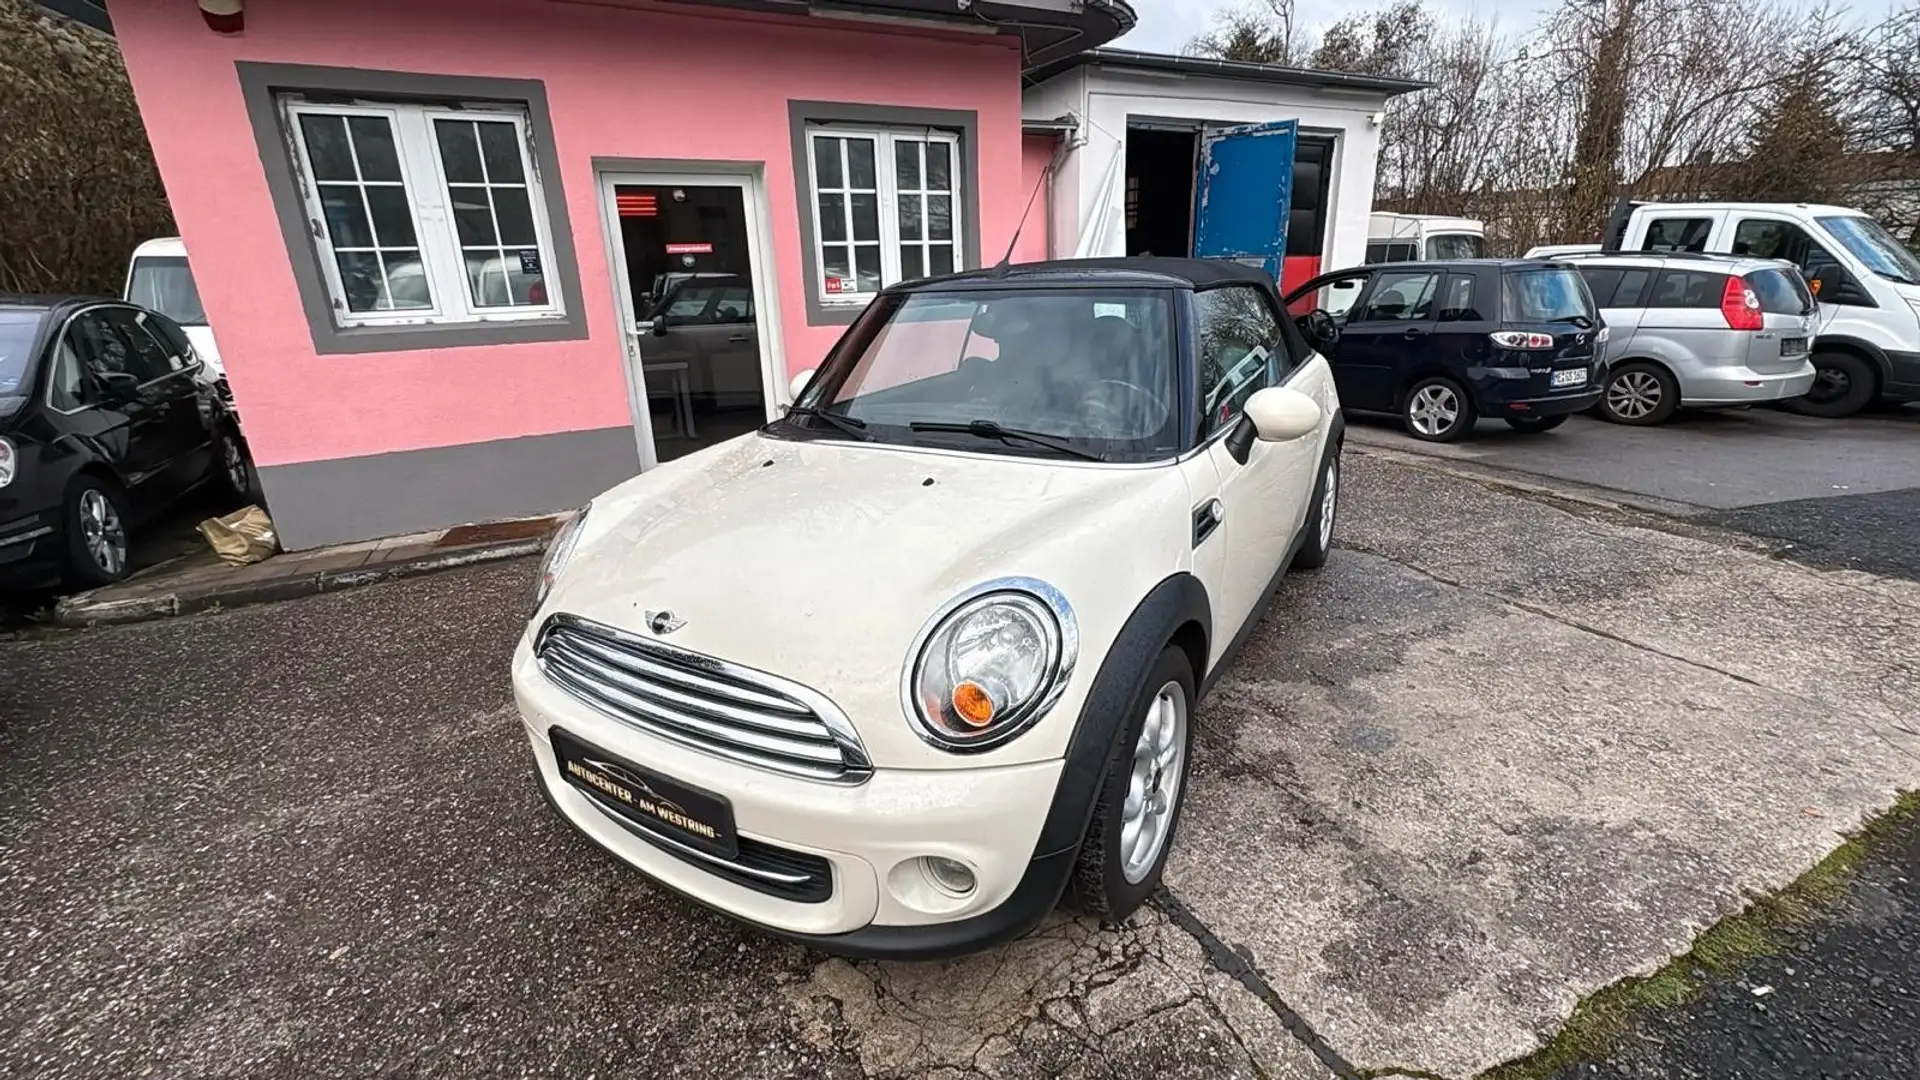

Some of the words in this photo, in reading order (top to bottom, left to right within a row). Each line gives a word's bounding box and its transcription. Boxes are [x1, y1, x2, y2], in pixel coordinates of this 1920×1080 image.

[567, 760, 632, 803] AUTOCENTER
[639, 799, 656, 816] AM
[657, 806, 715, 838] WESTRING
